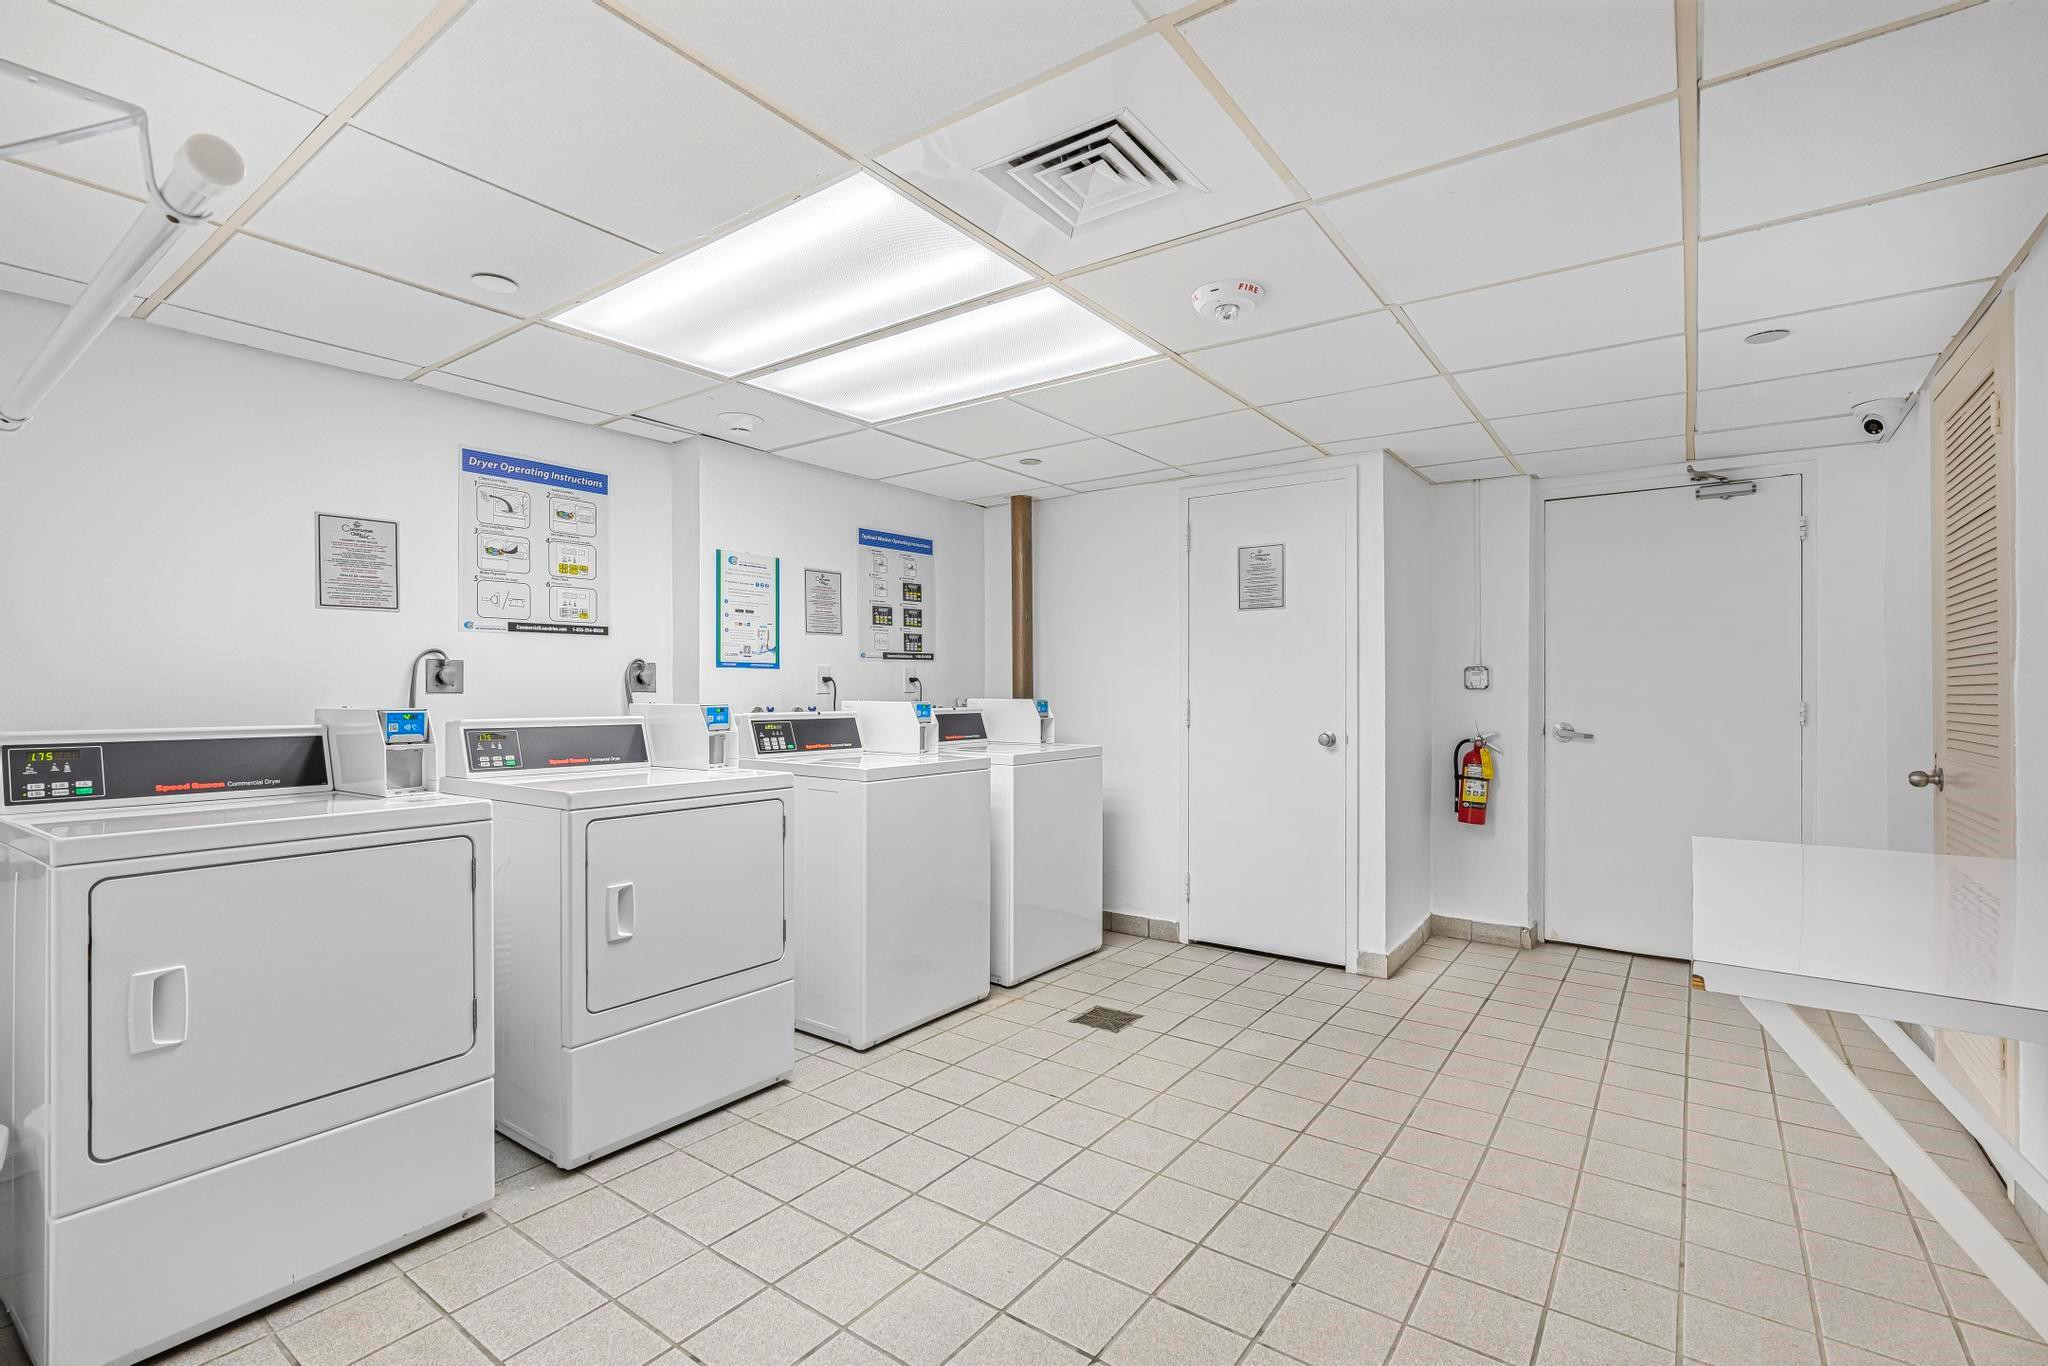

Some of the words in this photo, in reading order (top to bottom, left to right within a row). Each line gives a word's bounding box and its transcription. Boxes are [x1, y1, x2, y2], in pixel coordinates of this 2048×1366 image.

[1238, 282, 1260, 294] FIRE
[468, 456, 499, 470] Dryer
[500, 462, 550, 480] Operating
[551, 471, 603, 488] Instructions
[155, 783, 191, 792] Speed
[191, 781, 225, 789] Queen
[227, 779, 264, 787] Commercial
